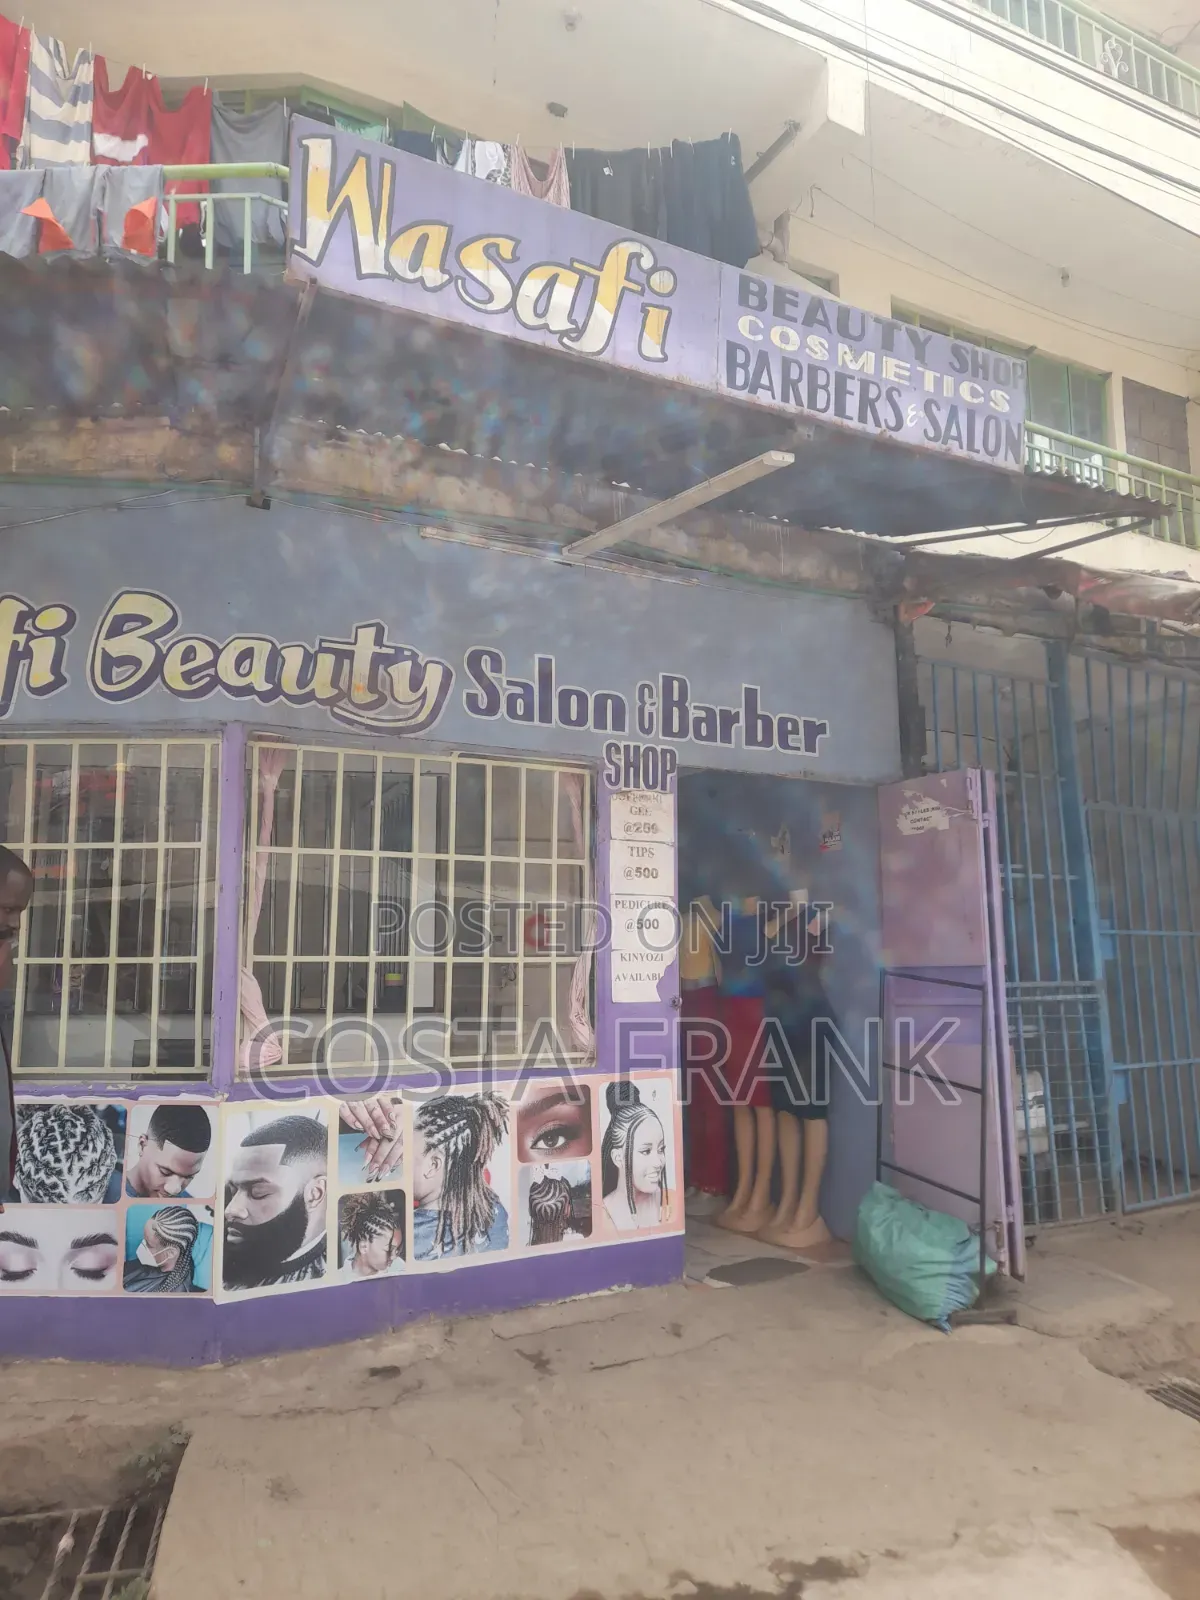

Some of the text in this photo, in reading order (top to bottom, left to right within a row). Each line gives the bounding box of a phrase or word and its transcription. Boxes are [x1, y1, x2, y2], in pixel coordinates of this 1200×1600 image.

[291, 134, 677, 362] Wasafi
[738, 273, 1027, 390] BEAUTY SHOP
[738, 315, 1012, 413] COSMETICS
[726, 340, 902, 432] BARBERS
[923, 397, 1022, 465] SALON
[87, 586, 456, 735] Beauty
[462, 645, 630, 735] Salon
[603, 739, 678, 792] SHOP
[627, 846, 655, 859] TIPS
[614, 899, 669, 910] PEDICURE
[620, 952, 664, 962] KINYOZI
